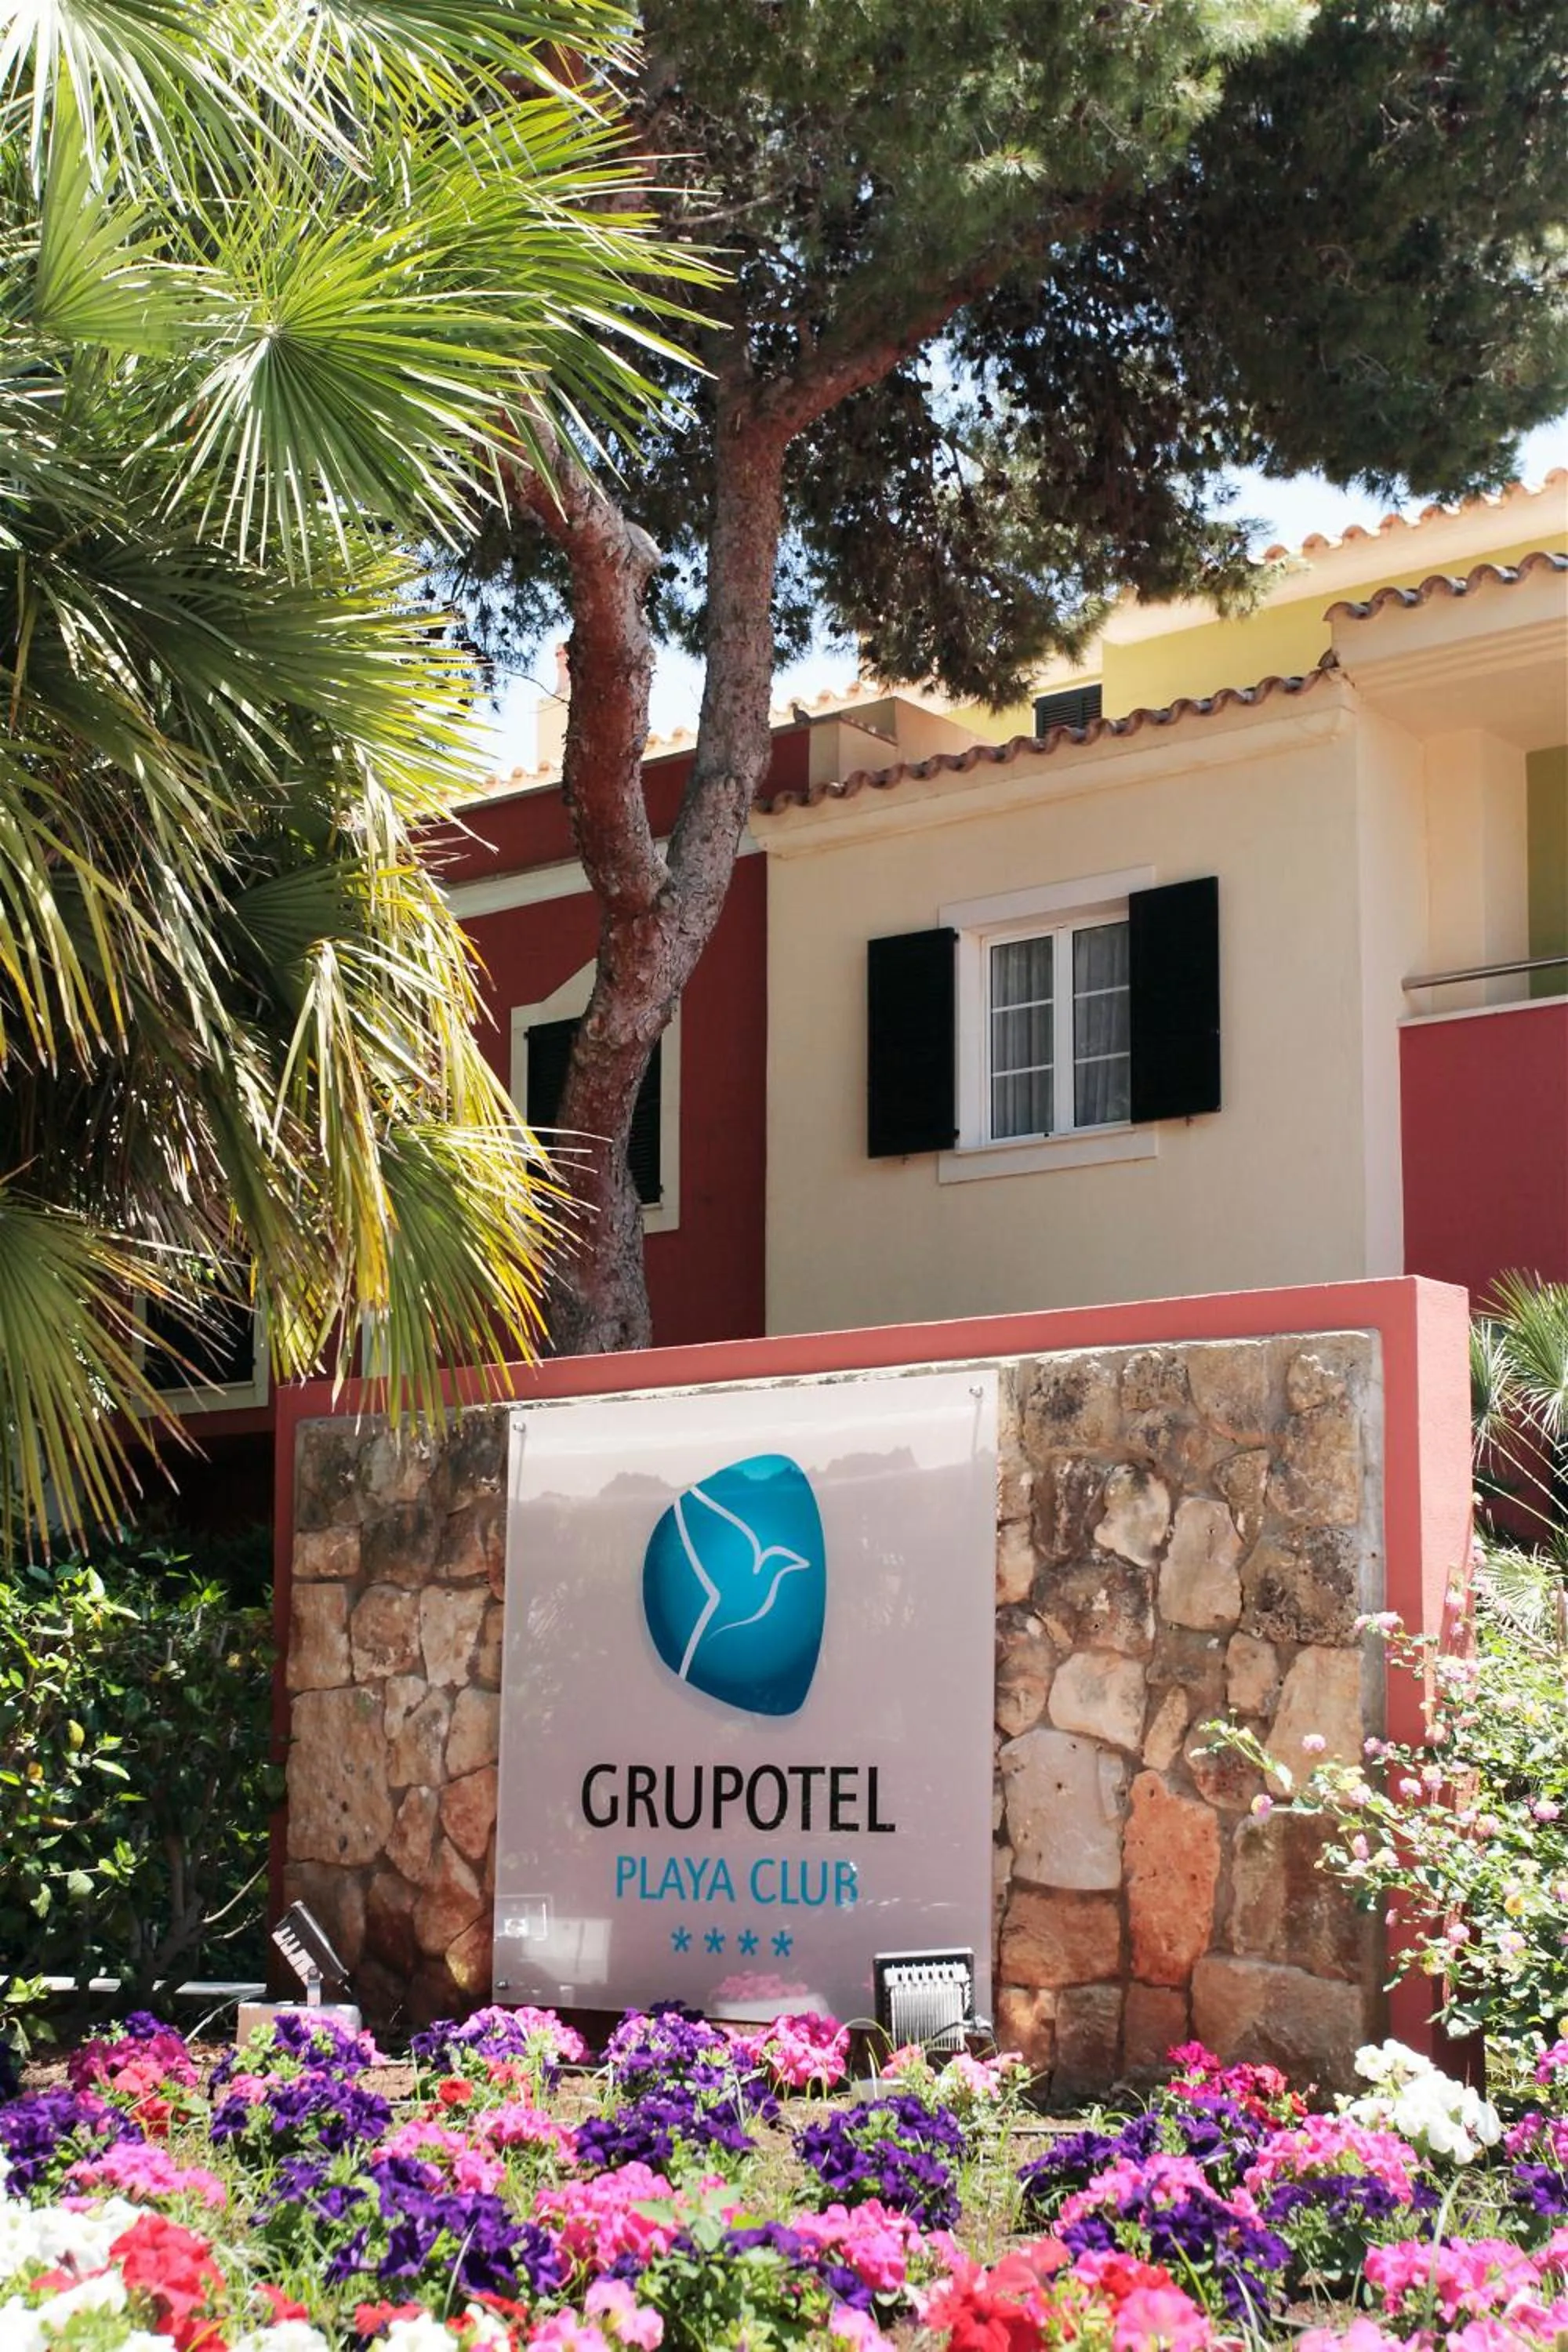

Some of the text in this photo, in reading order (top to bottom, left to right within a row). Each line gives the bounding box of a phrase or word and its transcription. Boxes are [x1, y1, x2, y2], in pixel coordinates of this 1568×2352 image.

[581, 1763, 896, 1833] GRUPOTEL
[616, 1855, 858, 1907] PLAYA CLUB
